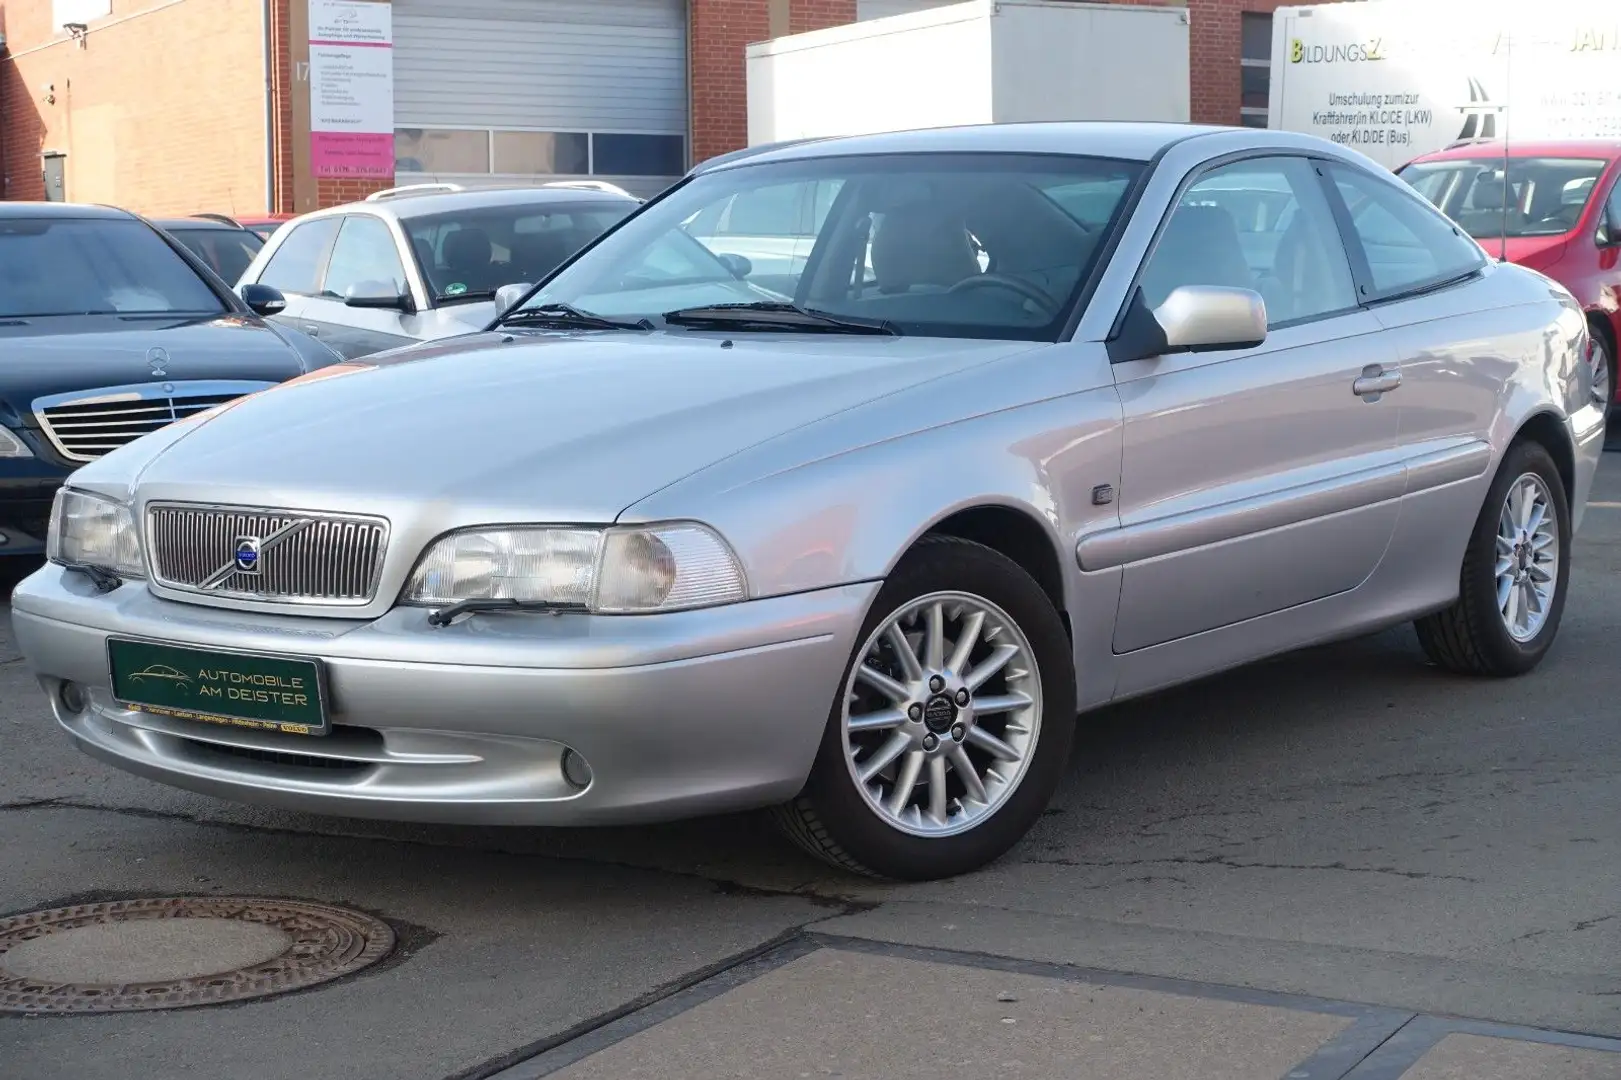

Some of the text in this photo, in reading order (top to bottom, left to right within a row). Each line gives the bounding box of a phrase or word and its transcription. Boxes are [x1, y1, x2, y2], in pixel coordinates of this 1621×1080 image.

[1328, 92, 1420, 108] Umschulung zum/zur
[1404, 110, 1433, 126] (LKW)
[198, 668, 304, 688] AUTOMOBILE
[199, 686, 308, 706] AM DEISTER
[282, 725, 308, 733] VOLVO
